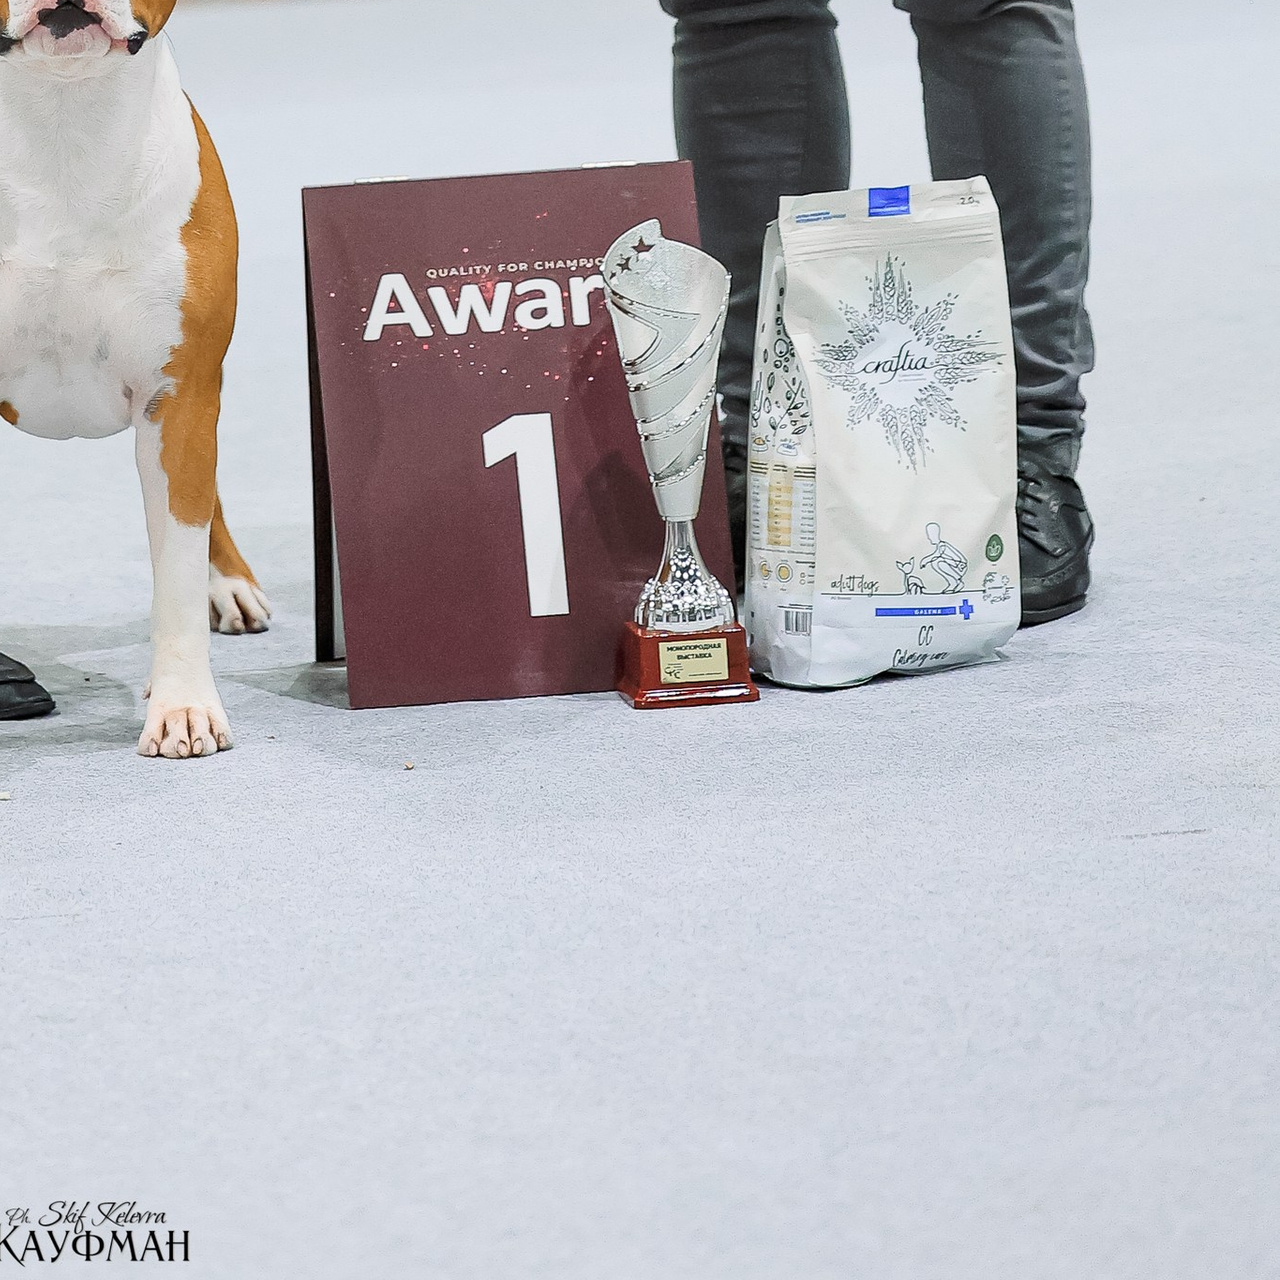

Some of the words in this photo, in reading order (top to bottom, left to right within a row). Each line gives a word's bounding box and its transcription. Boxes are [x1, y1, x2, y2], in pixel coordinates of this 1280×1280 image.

[426, 264, 491, 280] QUALITY
[497, 262, 528, 273] FOR
[533, 257, 606, 271] CHAMPIO
[362, 272, 607, 342] Awar
[845, 340, 948, 384] craftia
[481, 411, 571, 618] 1
